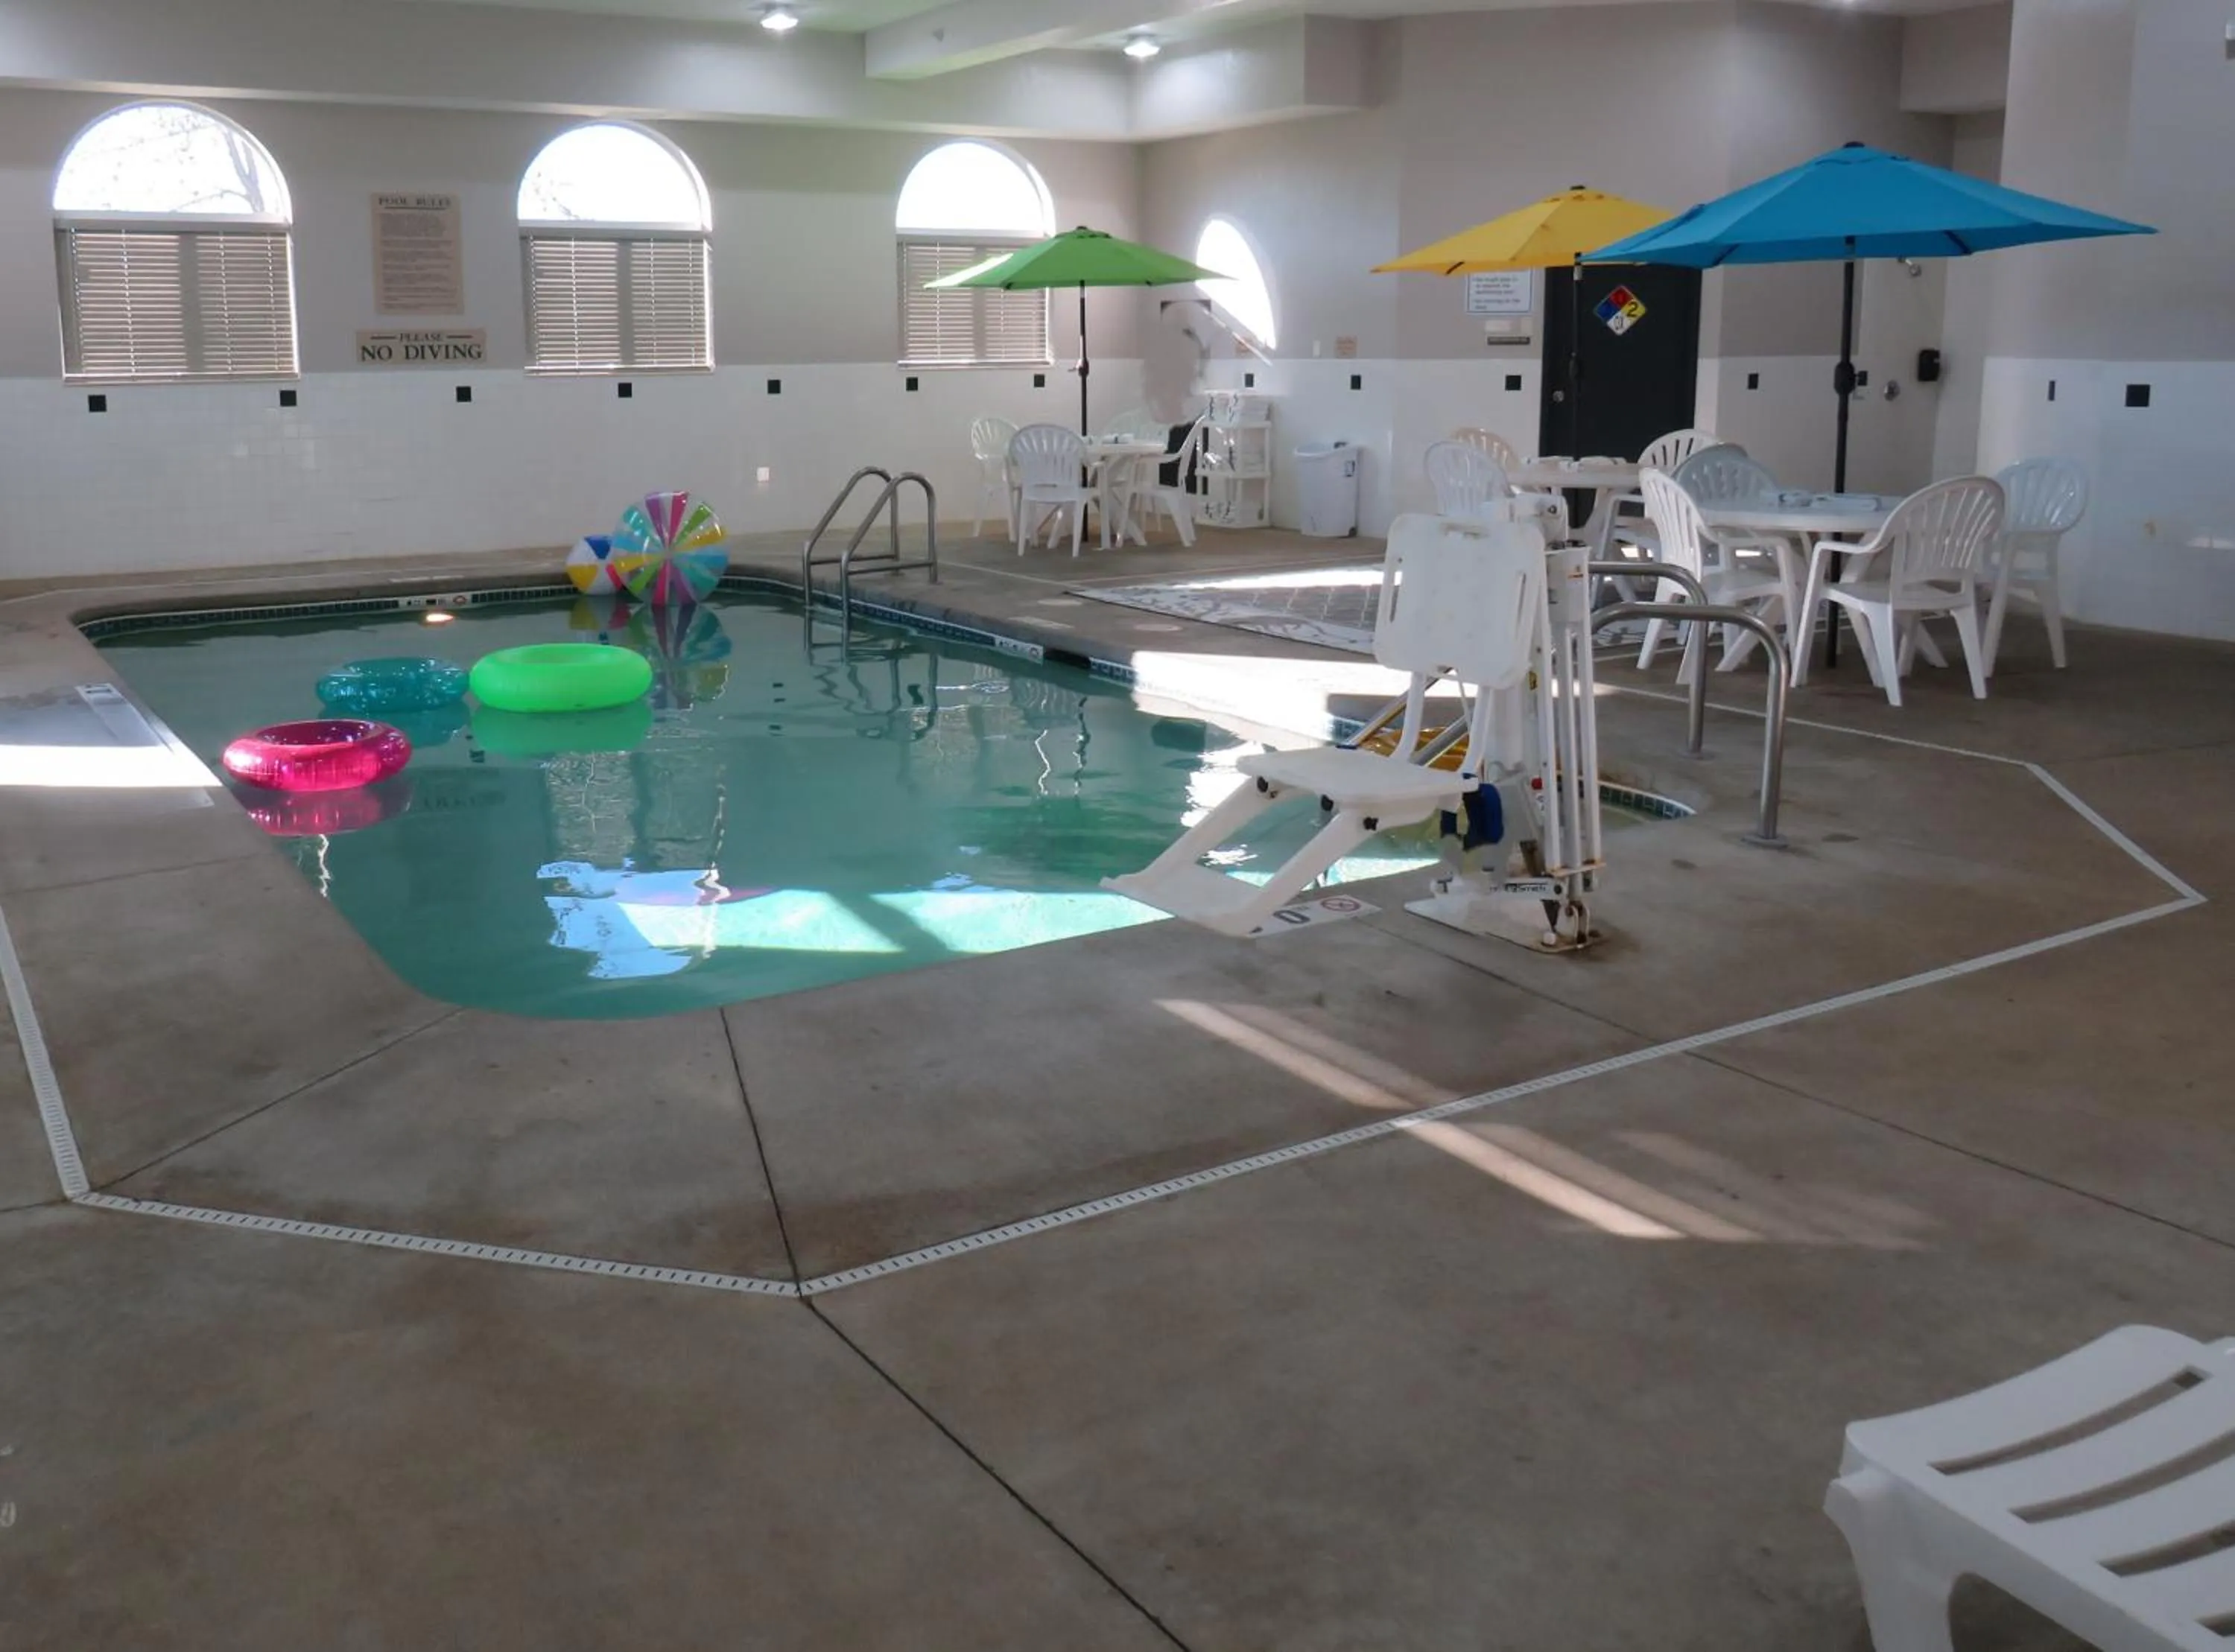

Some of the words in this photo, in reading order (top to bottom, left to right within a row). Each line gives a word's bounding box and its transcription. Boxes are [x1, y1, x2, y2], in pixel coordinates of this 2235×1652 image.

[1626, 301, 1639, 318] 2
[399, 333, 443, 343] PLEASE
[361, 345, 393, 361] NO
[404, 343, 483, 360] DIVING
